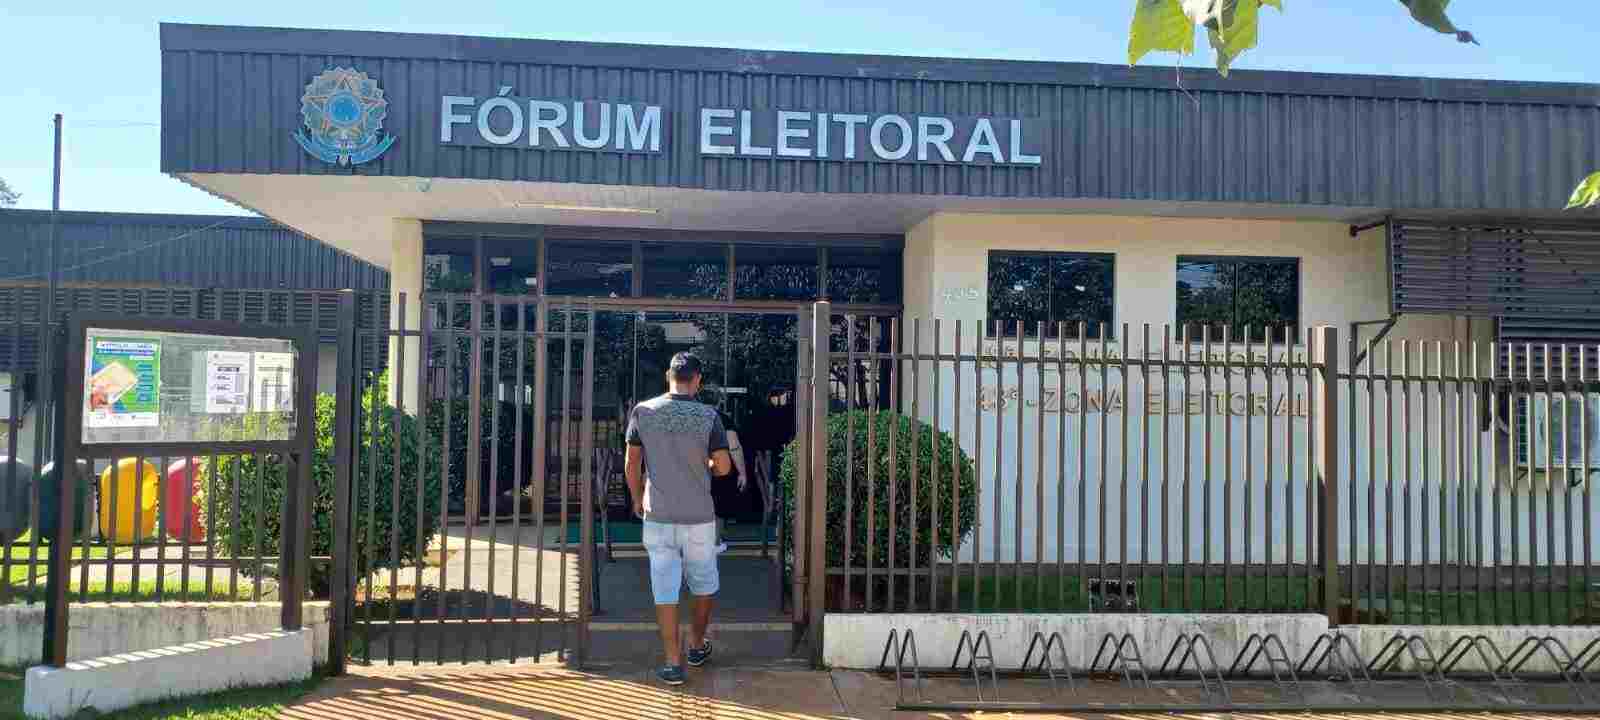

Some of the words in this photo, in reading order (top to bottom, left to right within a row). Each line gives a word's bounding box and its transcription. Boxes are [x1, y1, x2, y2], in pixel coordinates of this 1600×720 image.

[440, 86, 661, 151] FÓRUM
[700, 107, 1042, 164] ELEITORAL
[1041, 389, 1124, 415] ZONA
[1145, 391, 1310, 417] ELEITORAL
